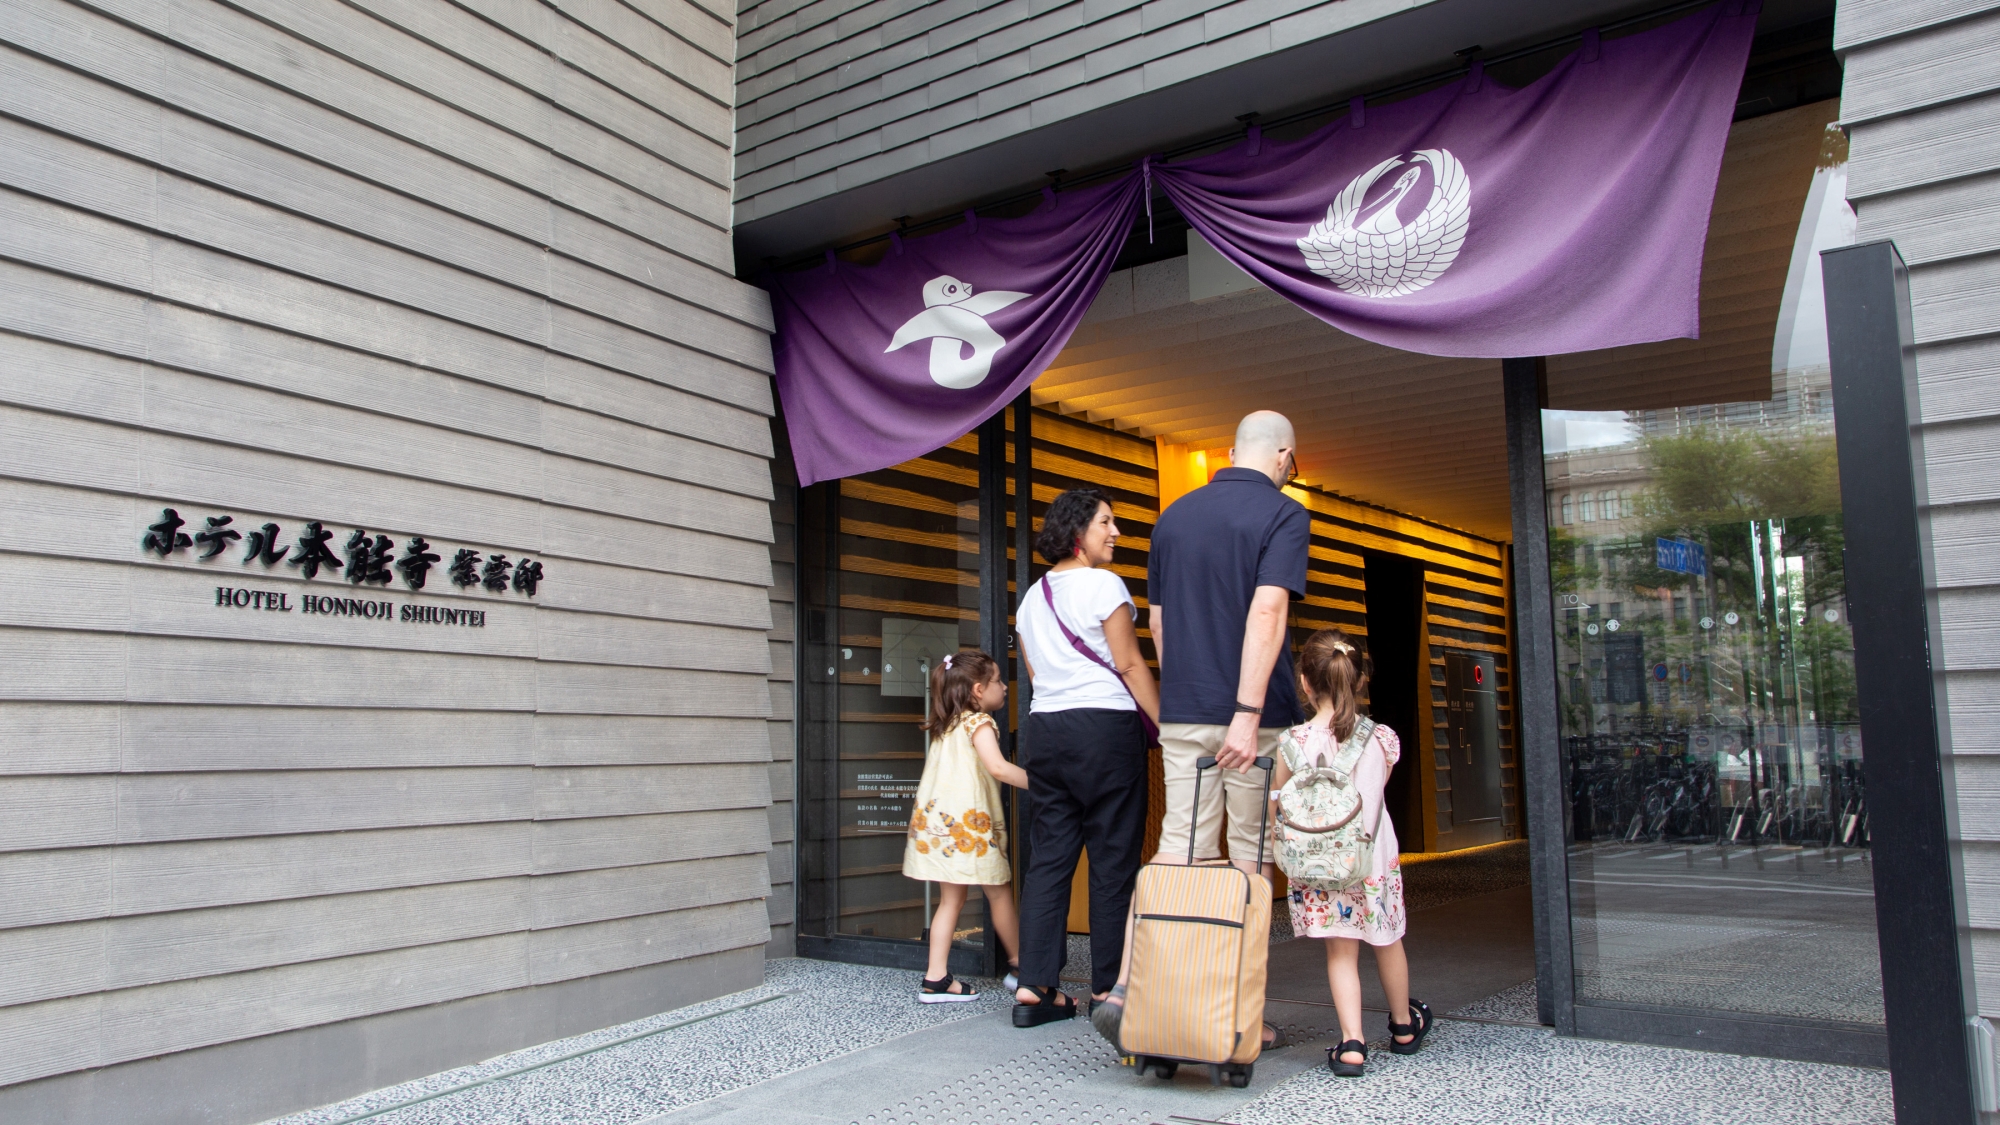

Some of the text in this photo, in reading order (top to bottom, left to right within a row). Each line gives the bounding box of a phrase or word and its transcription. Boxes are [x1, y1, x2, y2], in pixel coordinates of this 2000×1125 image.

[145, 508, 441, 589] ホテル本能寺
[215, 586, 487, 627] HOTEL HONNOJI SHIUNTEI
